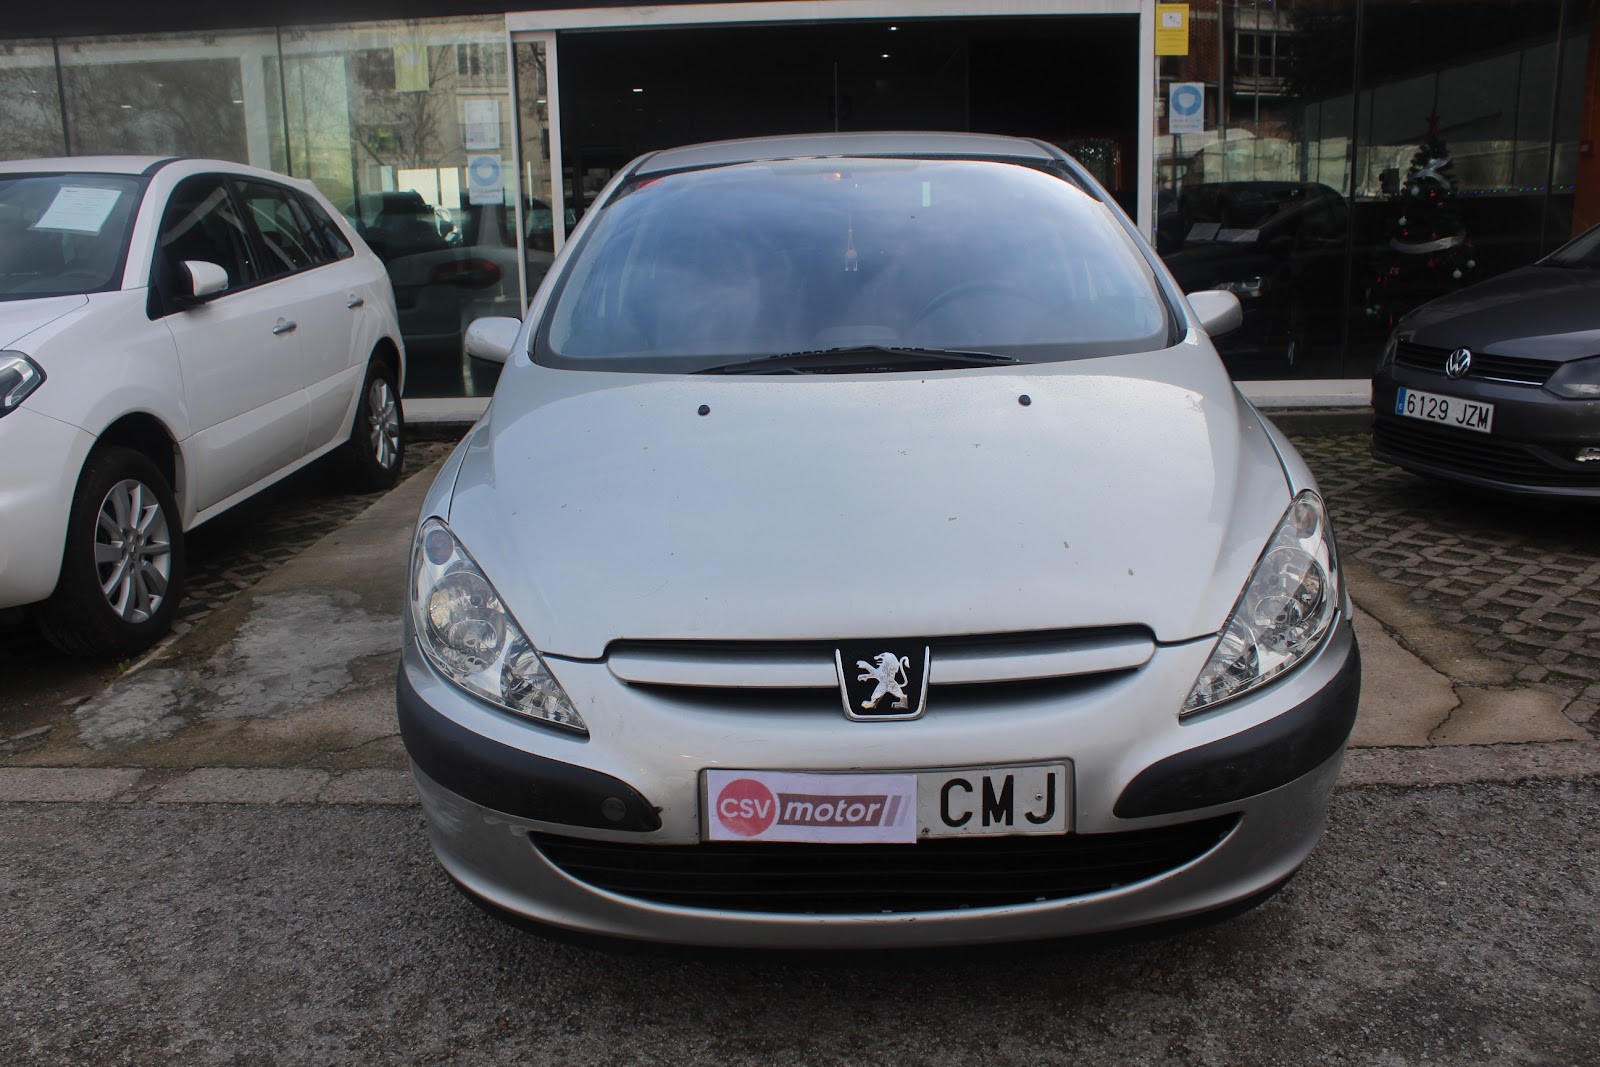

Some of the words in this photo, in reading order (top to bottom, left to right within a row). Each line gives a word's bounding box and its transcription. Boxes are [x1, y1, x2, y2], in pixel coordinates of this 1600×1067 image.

[1407, 393, 1449, 421] 6129
[1456, 403, 1490, 429] JZM
[720, 797, 775, 819] CSV
[783, 799, 881, 823] motor
[940, 772, 1056, 828] CMJ
